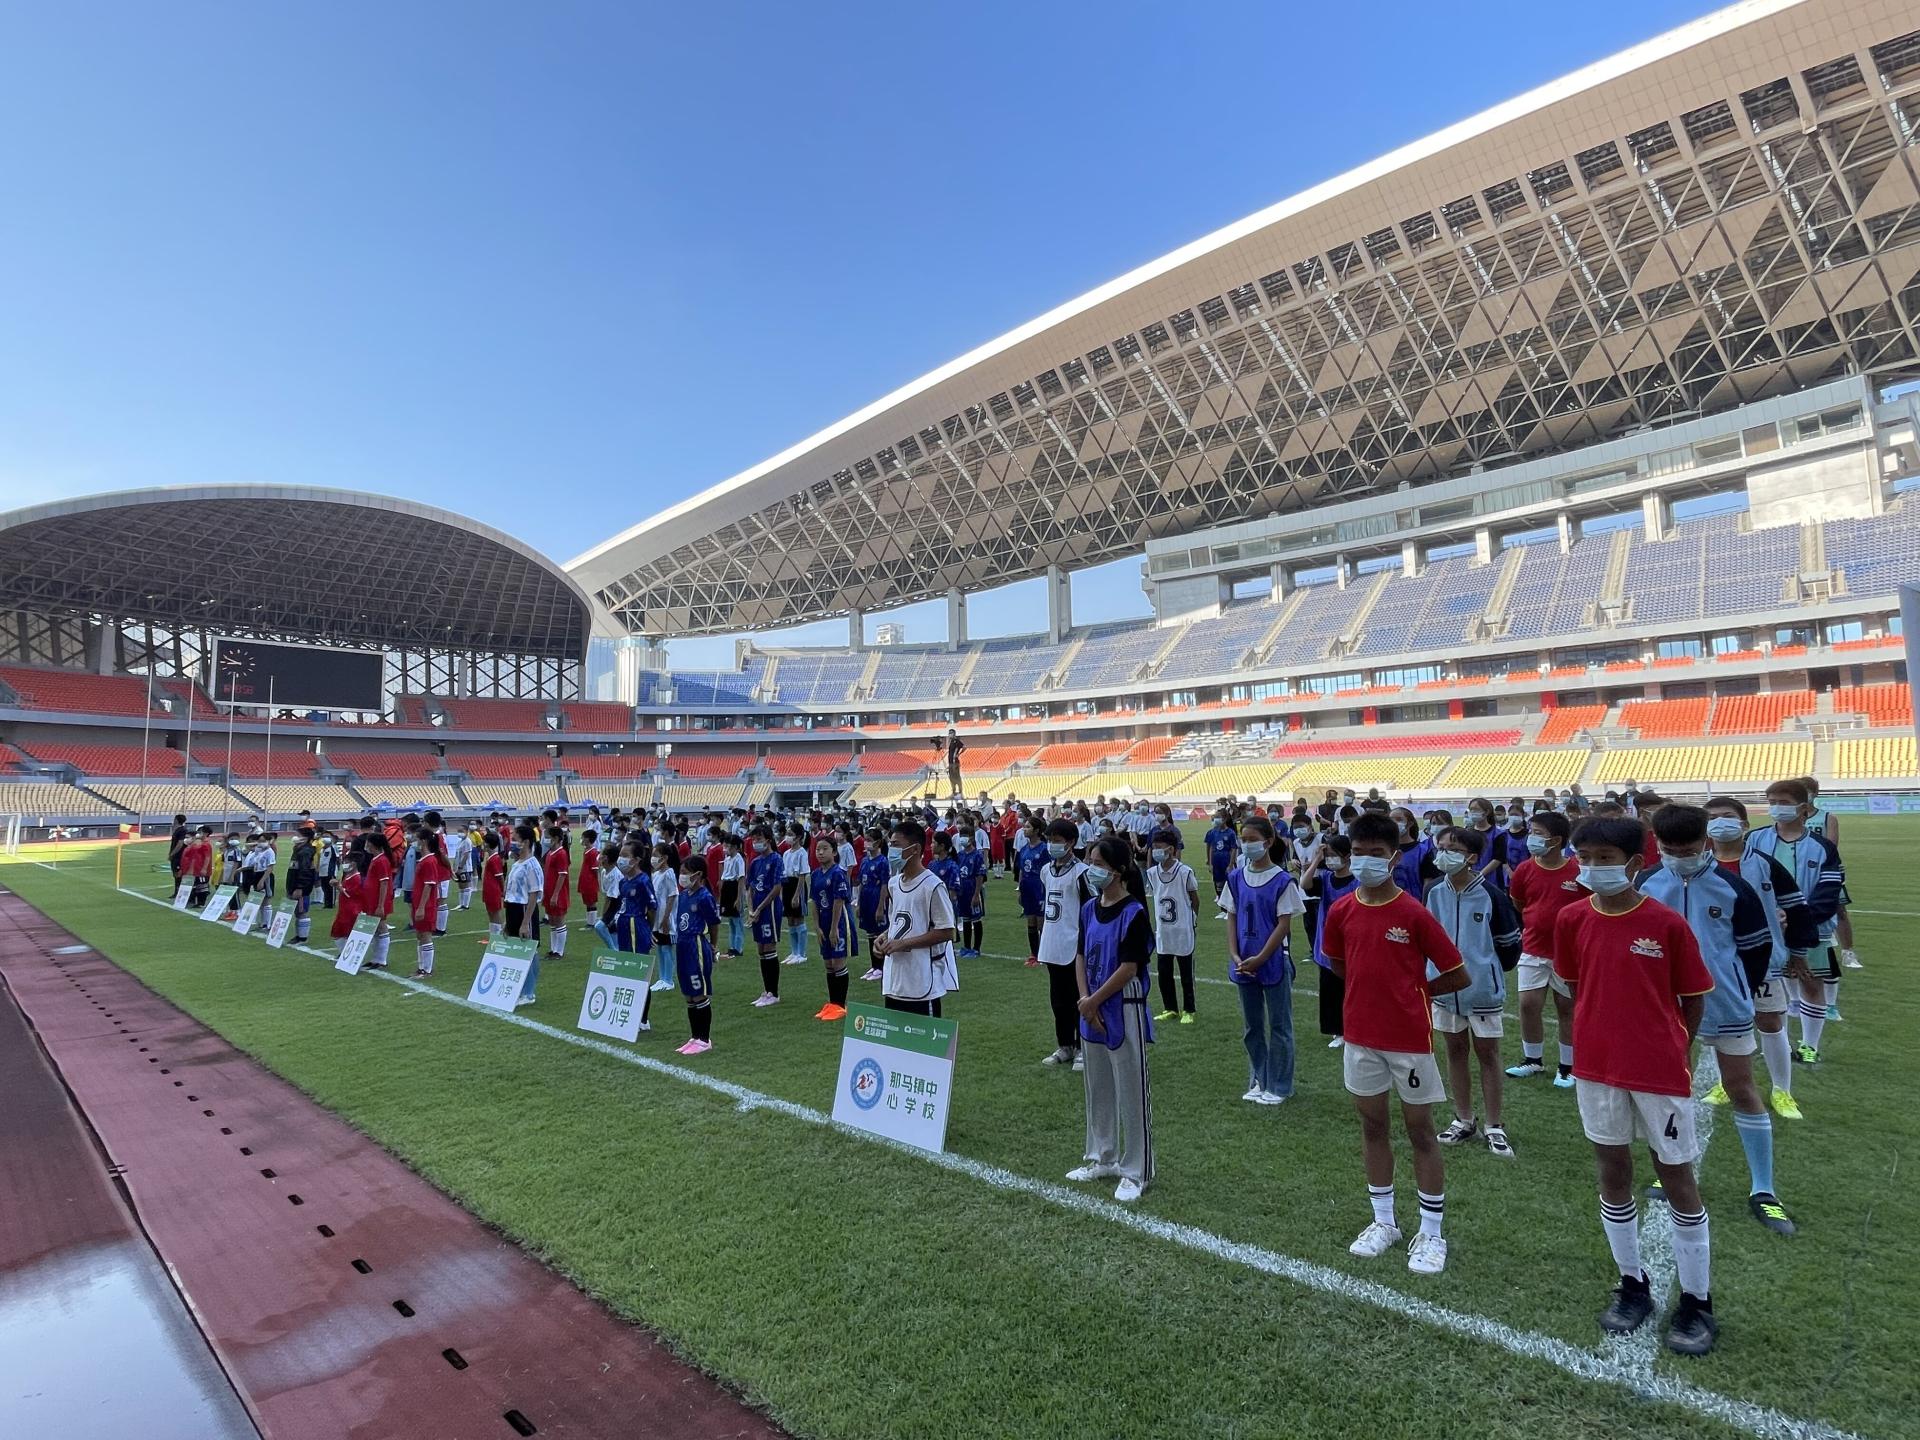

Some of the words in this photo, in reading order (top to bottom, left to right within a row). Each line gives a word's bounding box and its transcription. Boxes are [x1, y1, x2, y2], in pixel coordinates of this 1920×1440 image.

[1045, 889, 1063, 923] 5
[1159, 896, 1178, 925] 3
[679, 912, 690, 932] 3
[761, 924, 772, 937] 15
[894, 910, 914, 941] 2
[1243, 902, 1258, 938] 1
[497, 984, 512, 998] 小学
[690, 974, 702, 990] 5
[612, 987, 635, 1007] 新团
[608, 1007, 630, 1027] 小学
[889, 1071, 938, 1098] 那马镇中
[1408, 1068, 1420, 1089] 6
[886, 1093, 936, 1121] 心学校
[1664, 1113, 1679, 1140] 4
